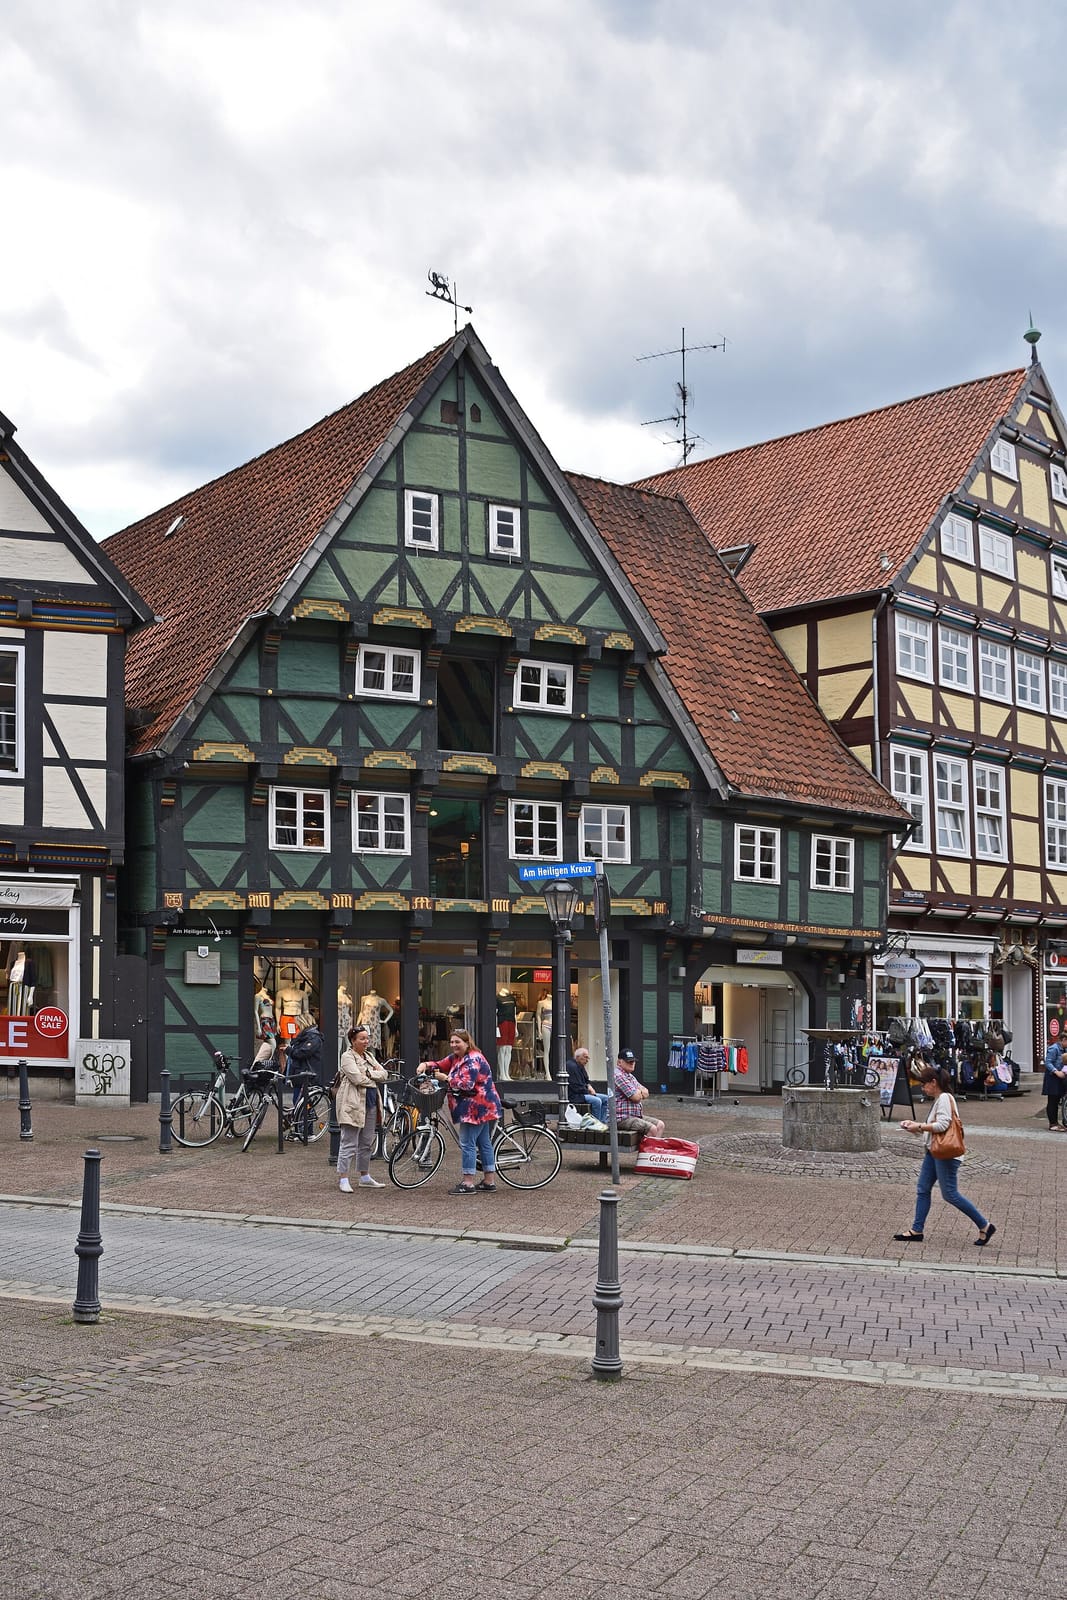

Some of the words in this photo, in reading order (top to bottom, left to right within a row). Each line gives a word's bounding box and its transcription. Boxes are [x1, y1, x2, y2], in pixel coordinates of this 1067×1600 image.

[523, 868, 535, 878] Am
[537, 866, 568, 877] Heiligen
[570, 865, 592, 874] Kreuz
[535, 972, 550, 981] mey
[39, 1015, 64, 1023] FINAL
[0, 1021, 29, 1048] E
[649, 1154, 676, 1164] Gebers
